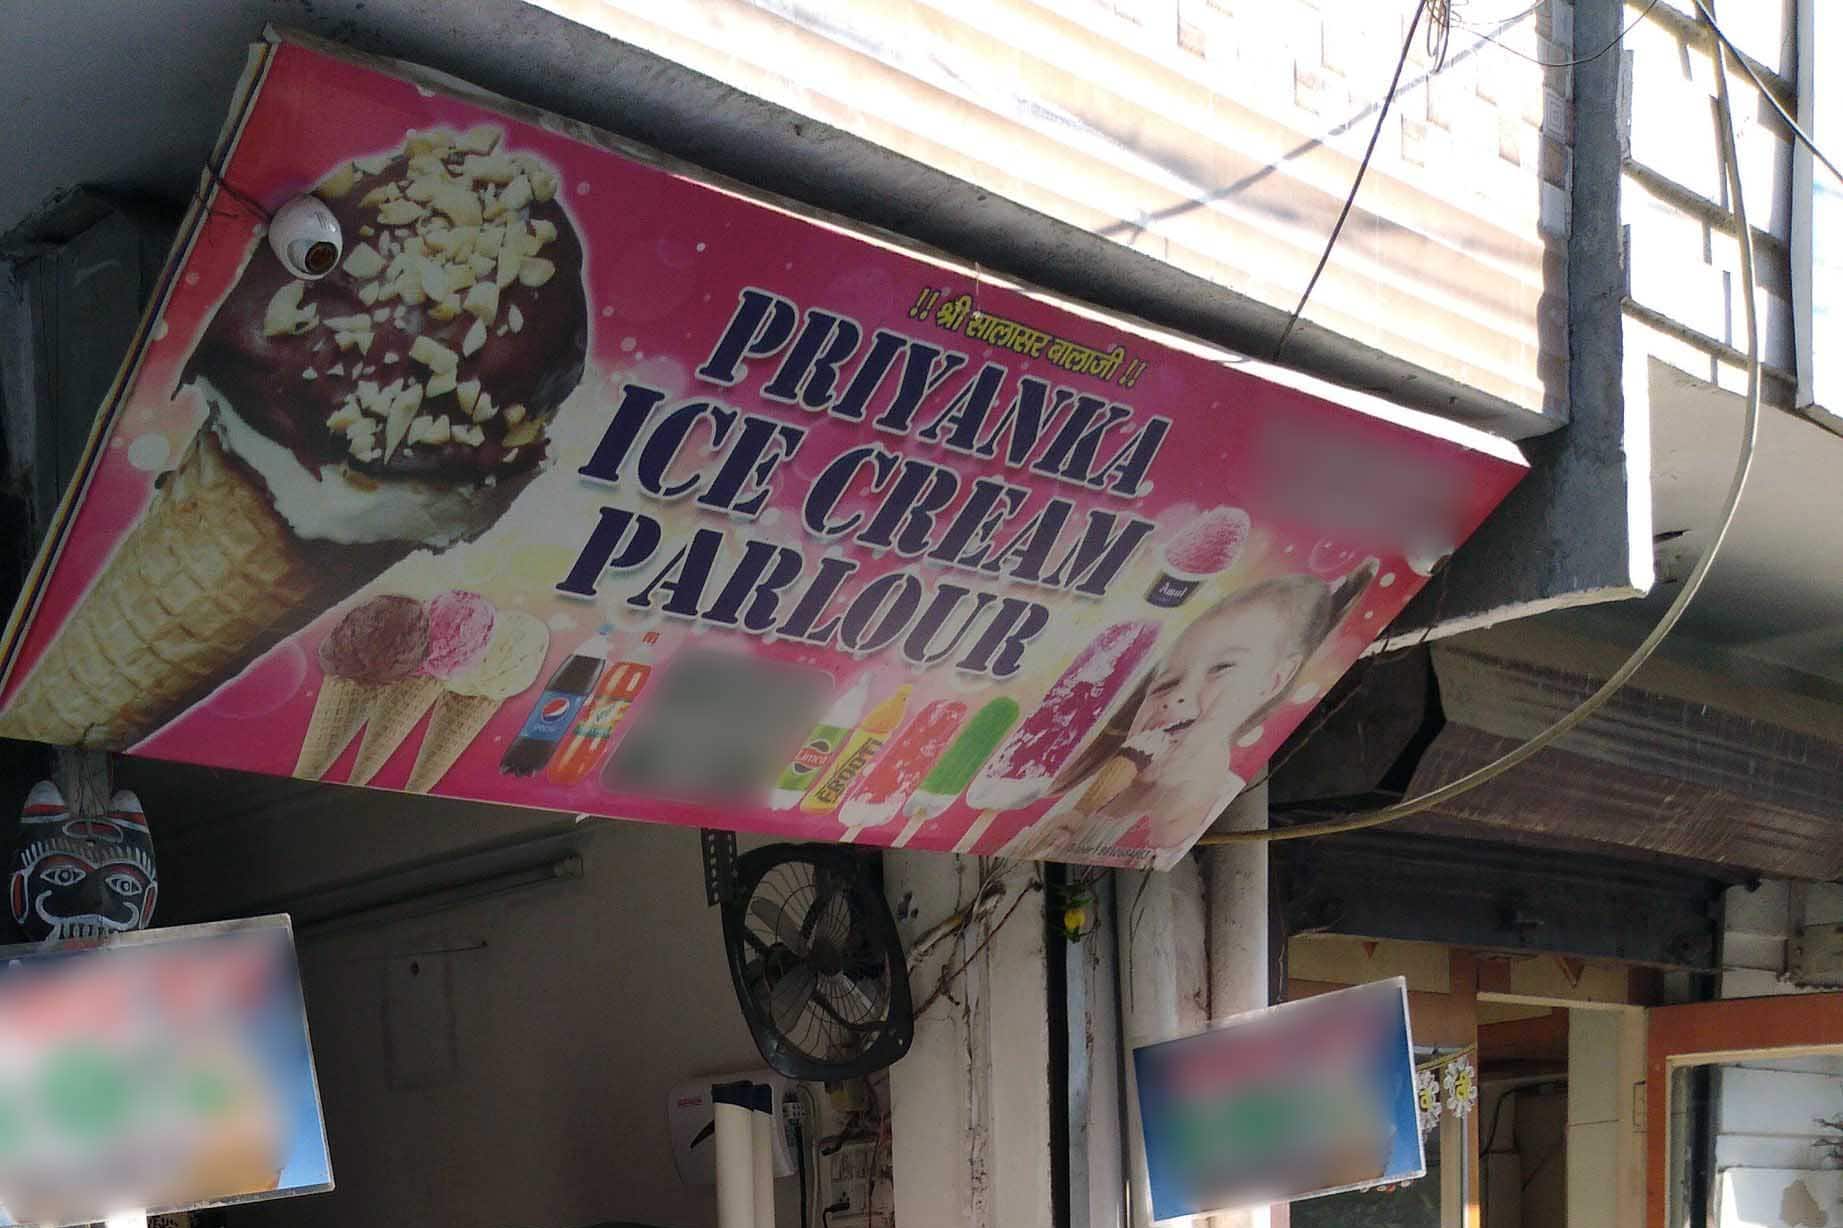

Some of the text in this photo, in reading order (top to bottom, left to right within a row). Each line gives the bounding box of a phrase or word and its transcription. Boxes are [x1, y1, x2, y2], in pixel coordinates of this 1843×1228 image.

[697, 288, 1173, 495] PRIYANKA
[936, 295, 974, 332] श्री
[966, 311, 1051, 359] सालासर
[1047, 336, 1127, 382] बालाजी
[580, 385, 1153, 597] ICE CREAM
[556, 507, 1049, 677] PARLOUR
